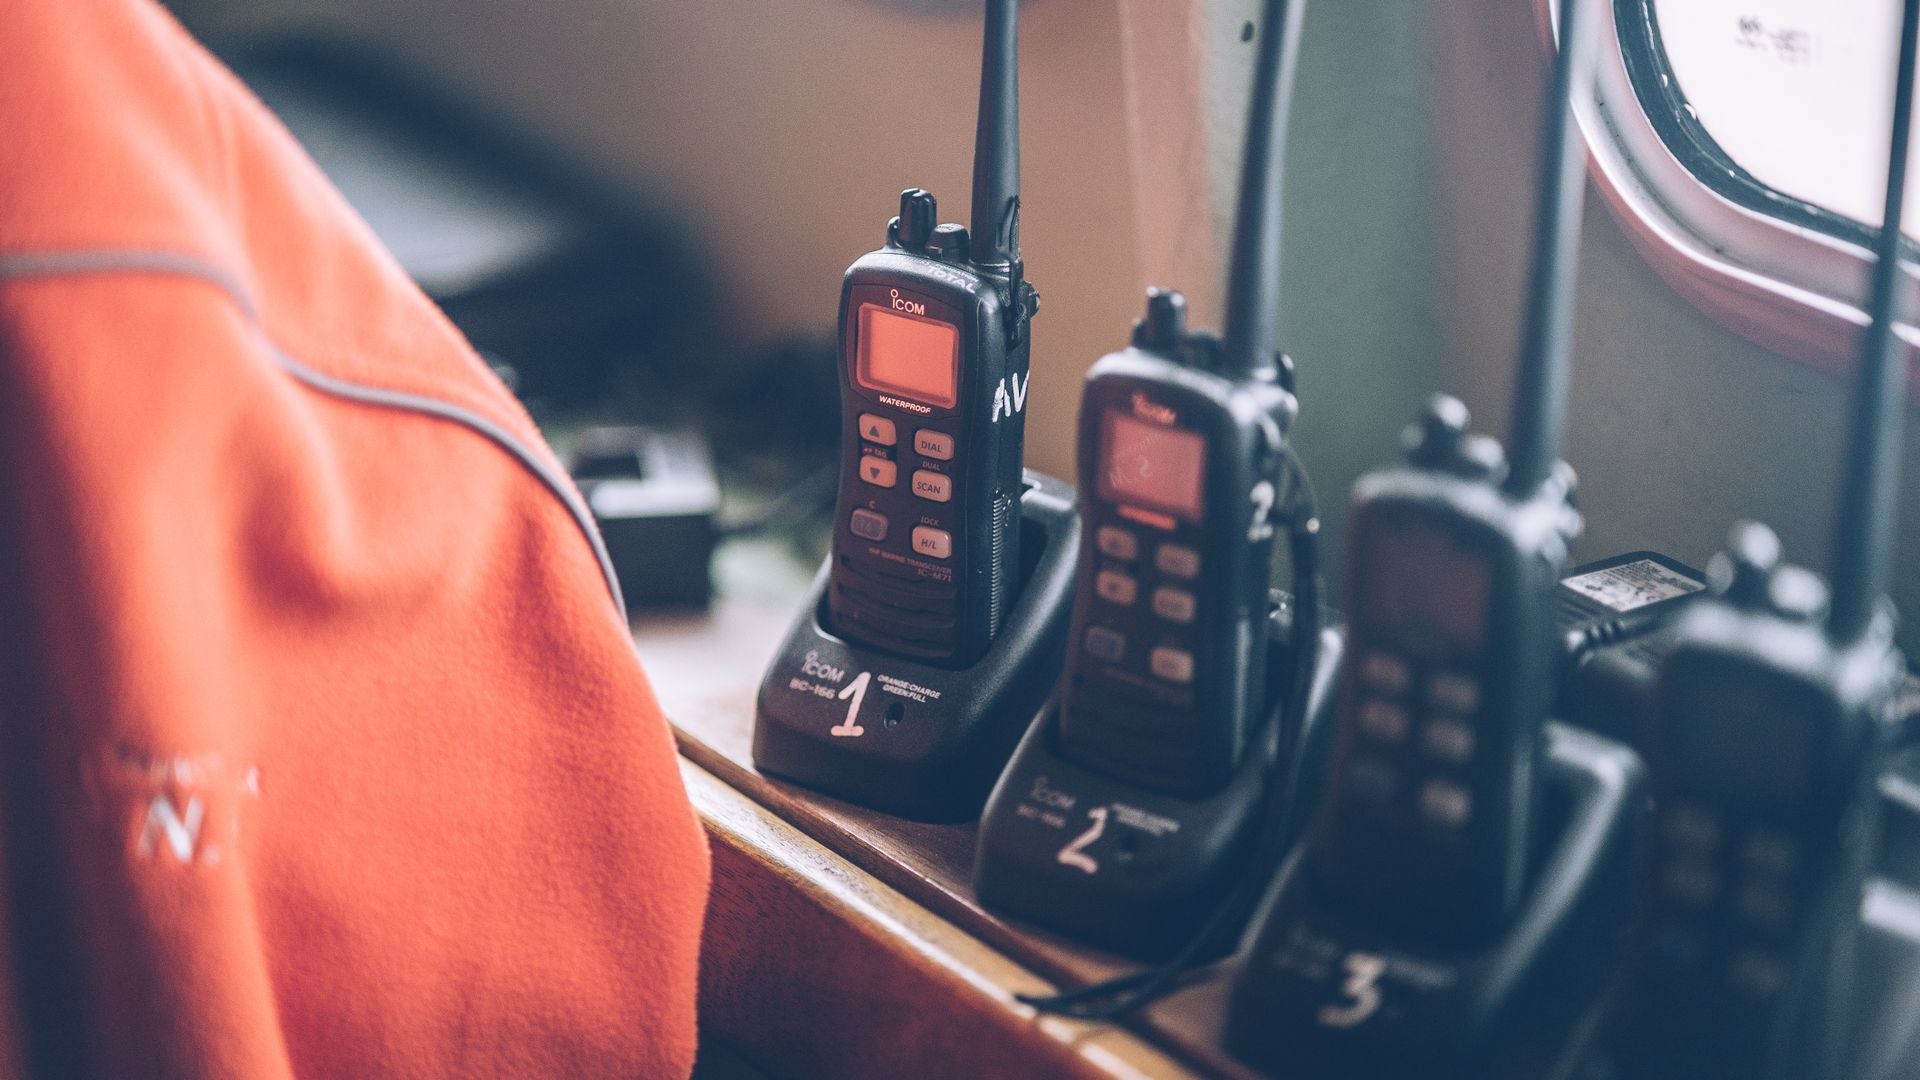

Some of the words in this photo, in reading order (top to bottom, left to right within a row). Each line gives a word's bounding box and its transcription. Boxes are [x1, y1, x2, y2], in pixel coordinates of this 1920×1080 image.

[926, 265, 976, 293] TOTAL
[879, 395, 932, 414] WATERPROOF
[921, 440, 942, 453] DIAL
[922, 461, 940, 471] DUAL
[917, 481, 941, 494] SCAN
[921, 515, 940, 526] LOCK
[1246, 481, 1275, 542] 2
[921, 538, 937, 550] H/L
[789, 677, 836, 700] BC-166
[831, 671, 871, 737] 1
[1057, 807, 1107, 874] 2
[1317, 952, 1386, 1028] 3
